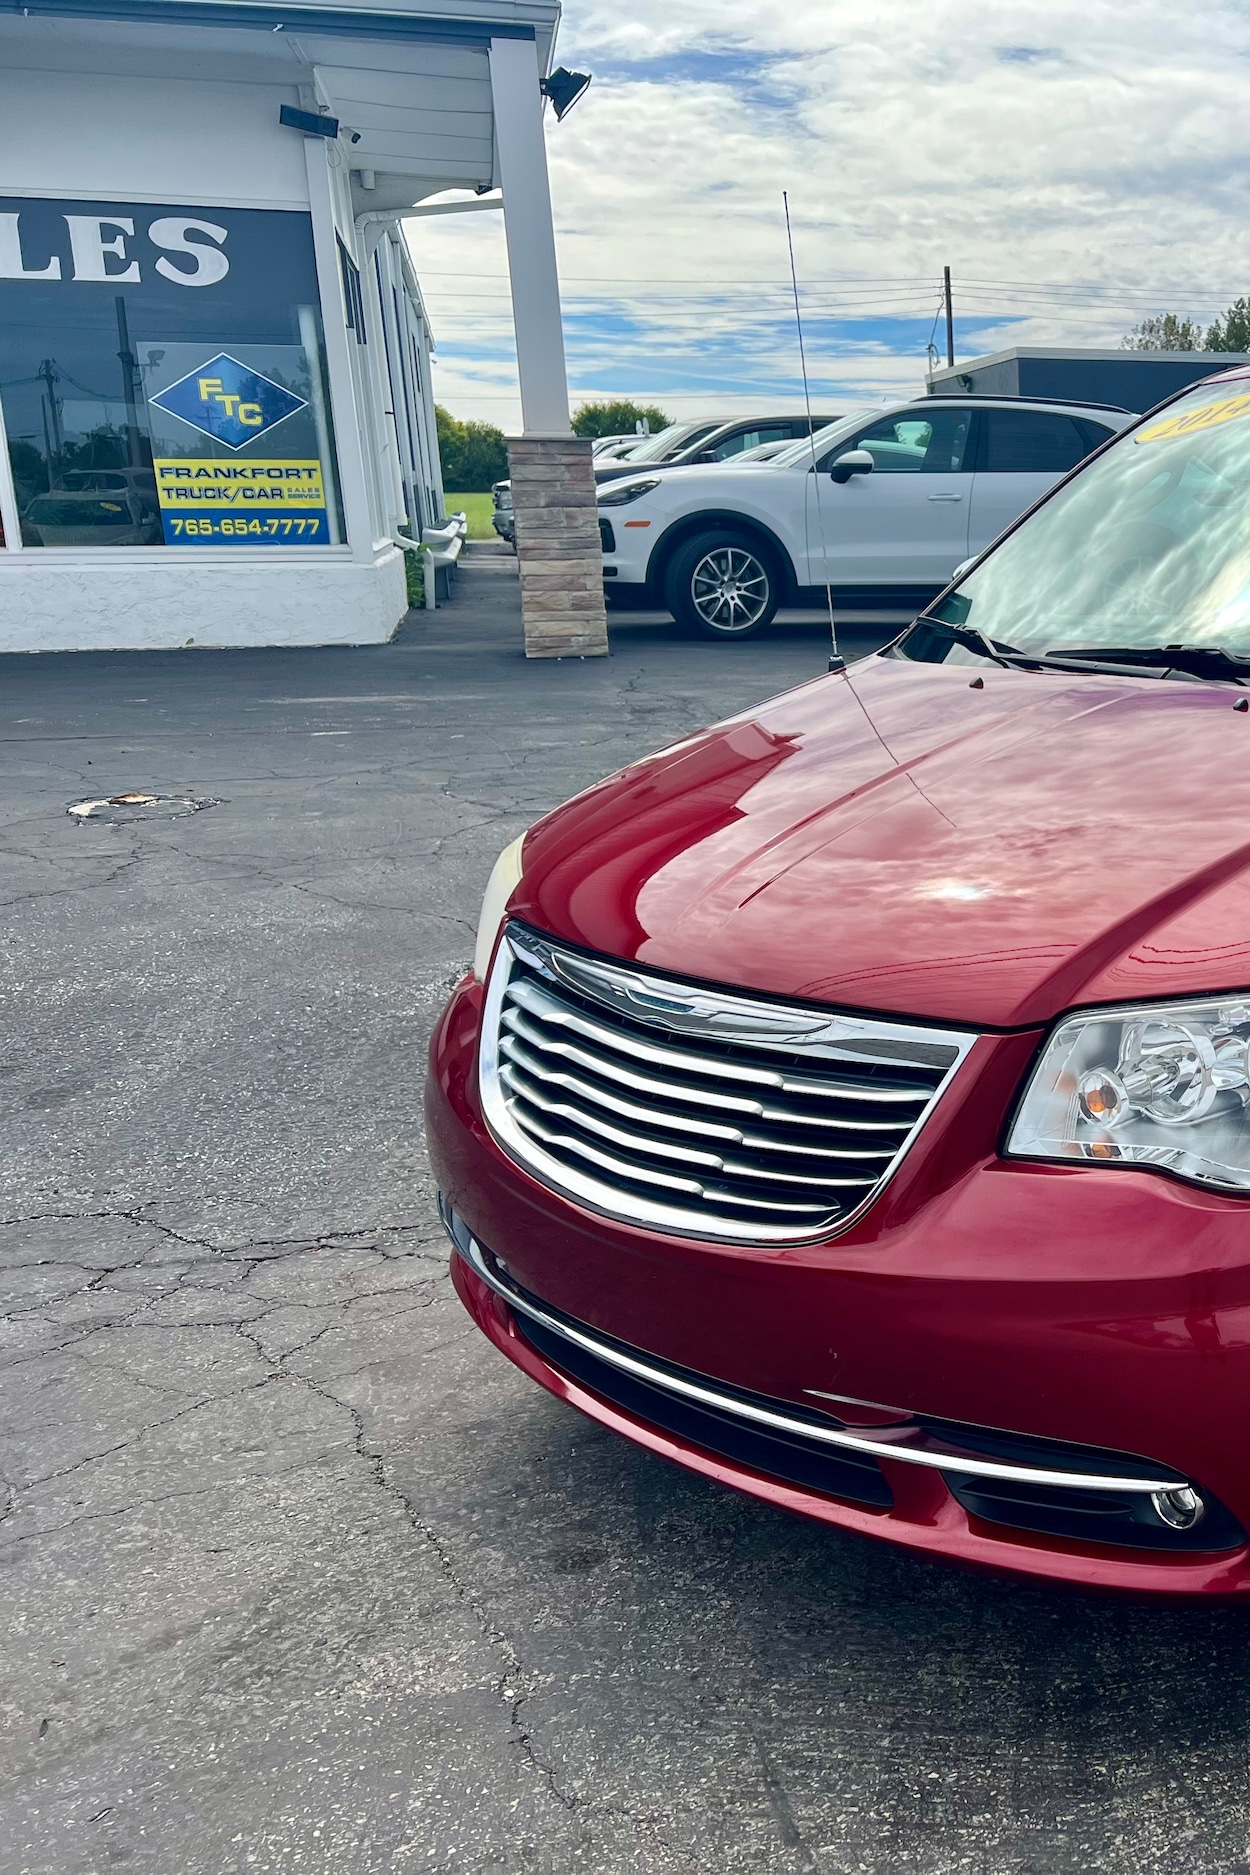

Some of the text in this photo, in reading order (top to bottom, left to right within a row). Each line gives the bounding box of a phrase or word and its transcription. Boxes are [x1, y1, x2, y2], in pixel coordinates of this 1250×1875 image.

[0, 213, 230, 287] LES
[198, 377, 264, 426] FTC
[158, 466, 318, 481] FRANKFORT
[161, 485, 285, 503] TRUCK/CAR
[170, 517, 321, 536] 765-654-7777
